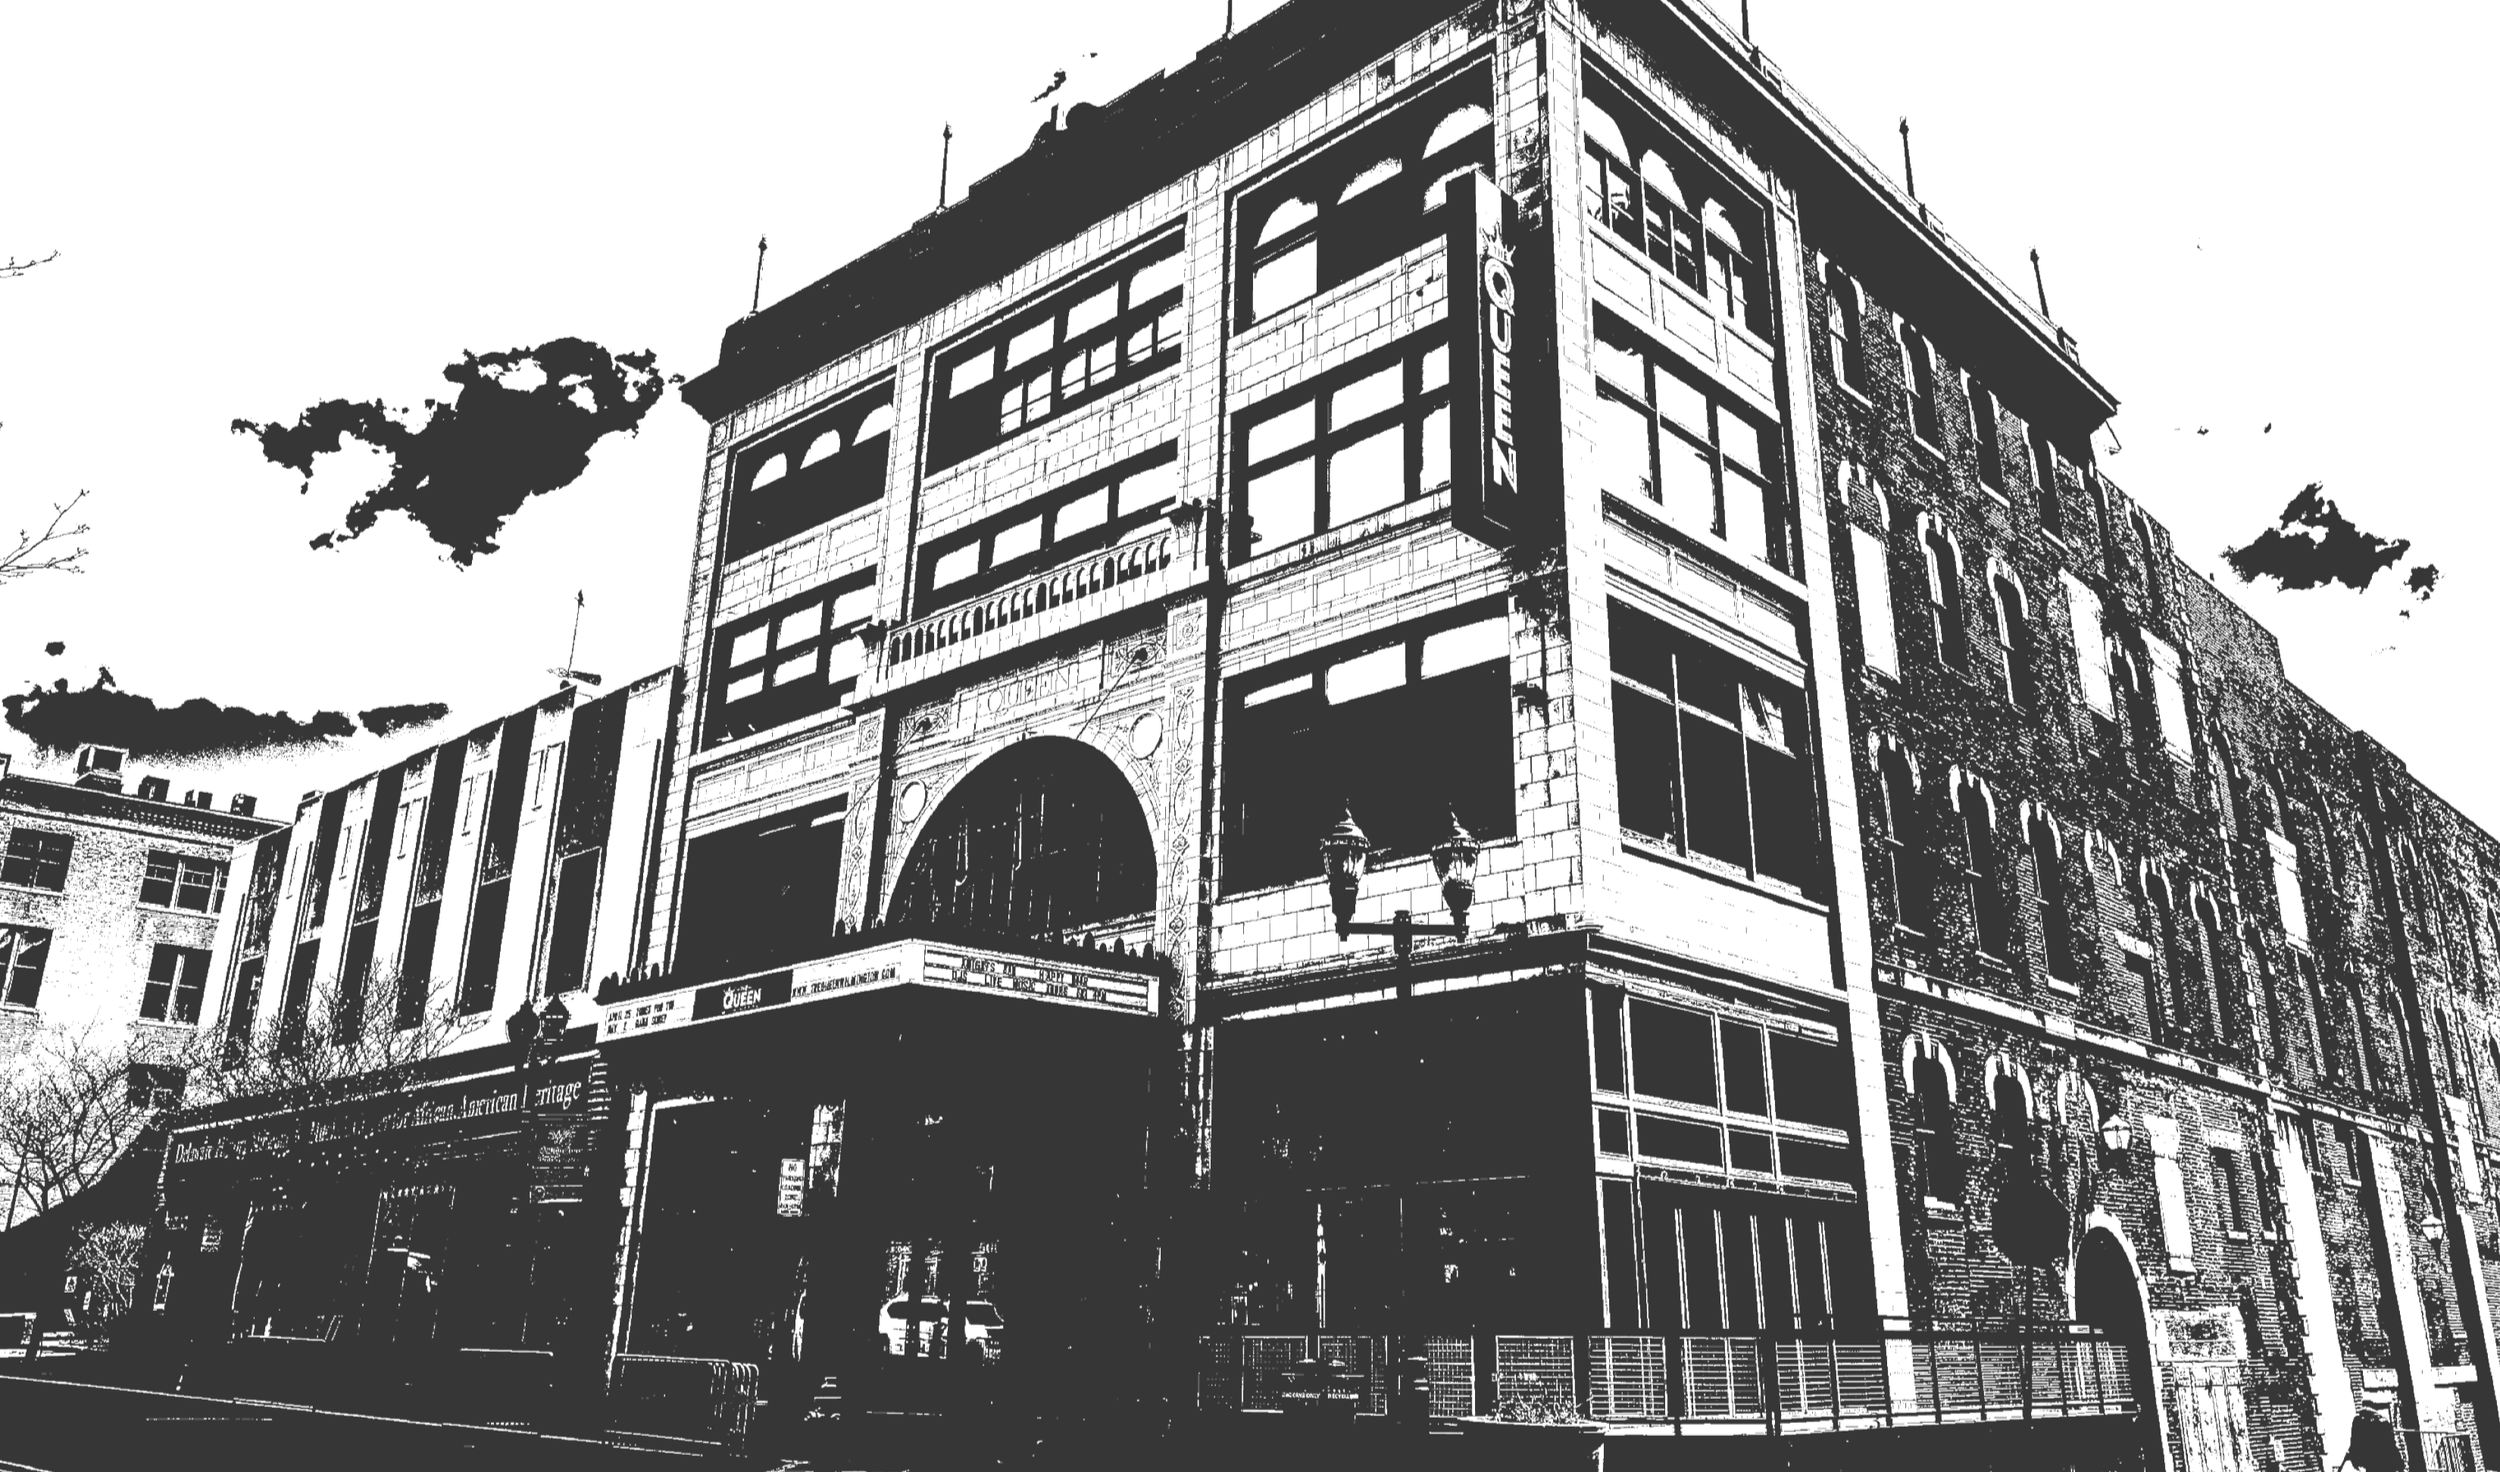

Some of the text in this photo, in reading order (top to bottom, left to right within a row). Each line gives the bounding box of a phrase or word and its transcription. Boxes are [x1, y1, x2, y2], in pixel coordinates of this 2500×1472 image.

[1484, 258, 1518, 494] QUEEN
[987, 663, 1071, 716] QUEEN
[723, 987, 762, 1009] QUEEN
